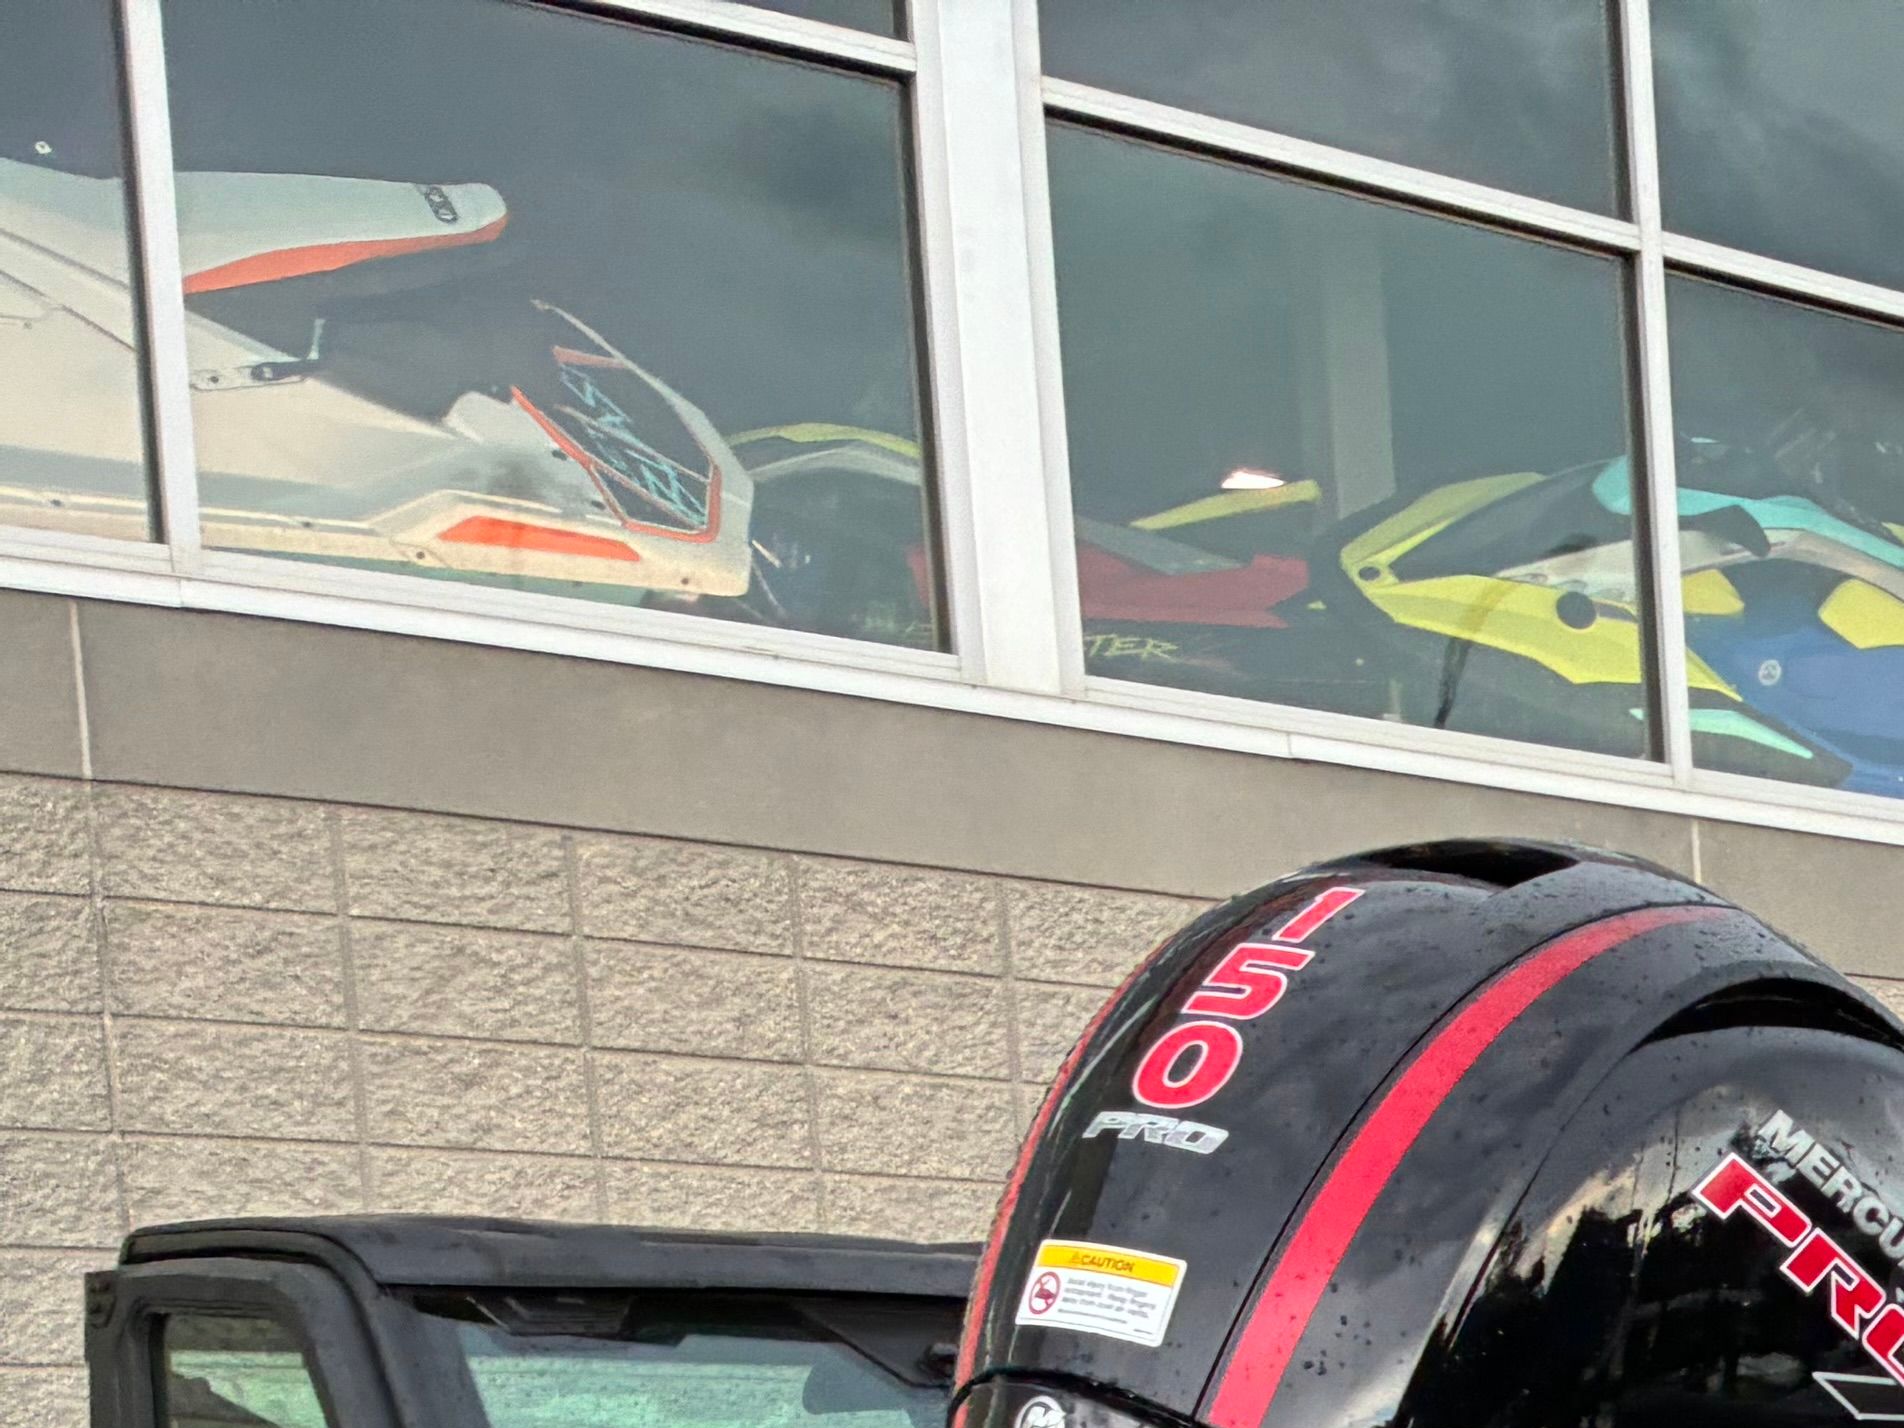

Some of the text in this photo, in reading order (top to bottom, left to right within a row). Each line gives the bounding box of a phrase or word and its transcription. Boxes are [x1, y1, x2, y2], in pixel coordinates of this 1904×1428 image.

[1131, 885, 1366, 1111] 150
[1082, 1111, 1231, 1155] PRO
[1081, 1255, 1135, 1273] CAUTION
